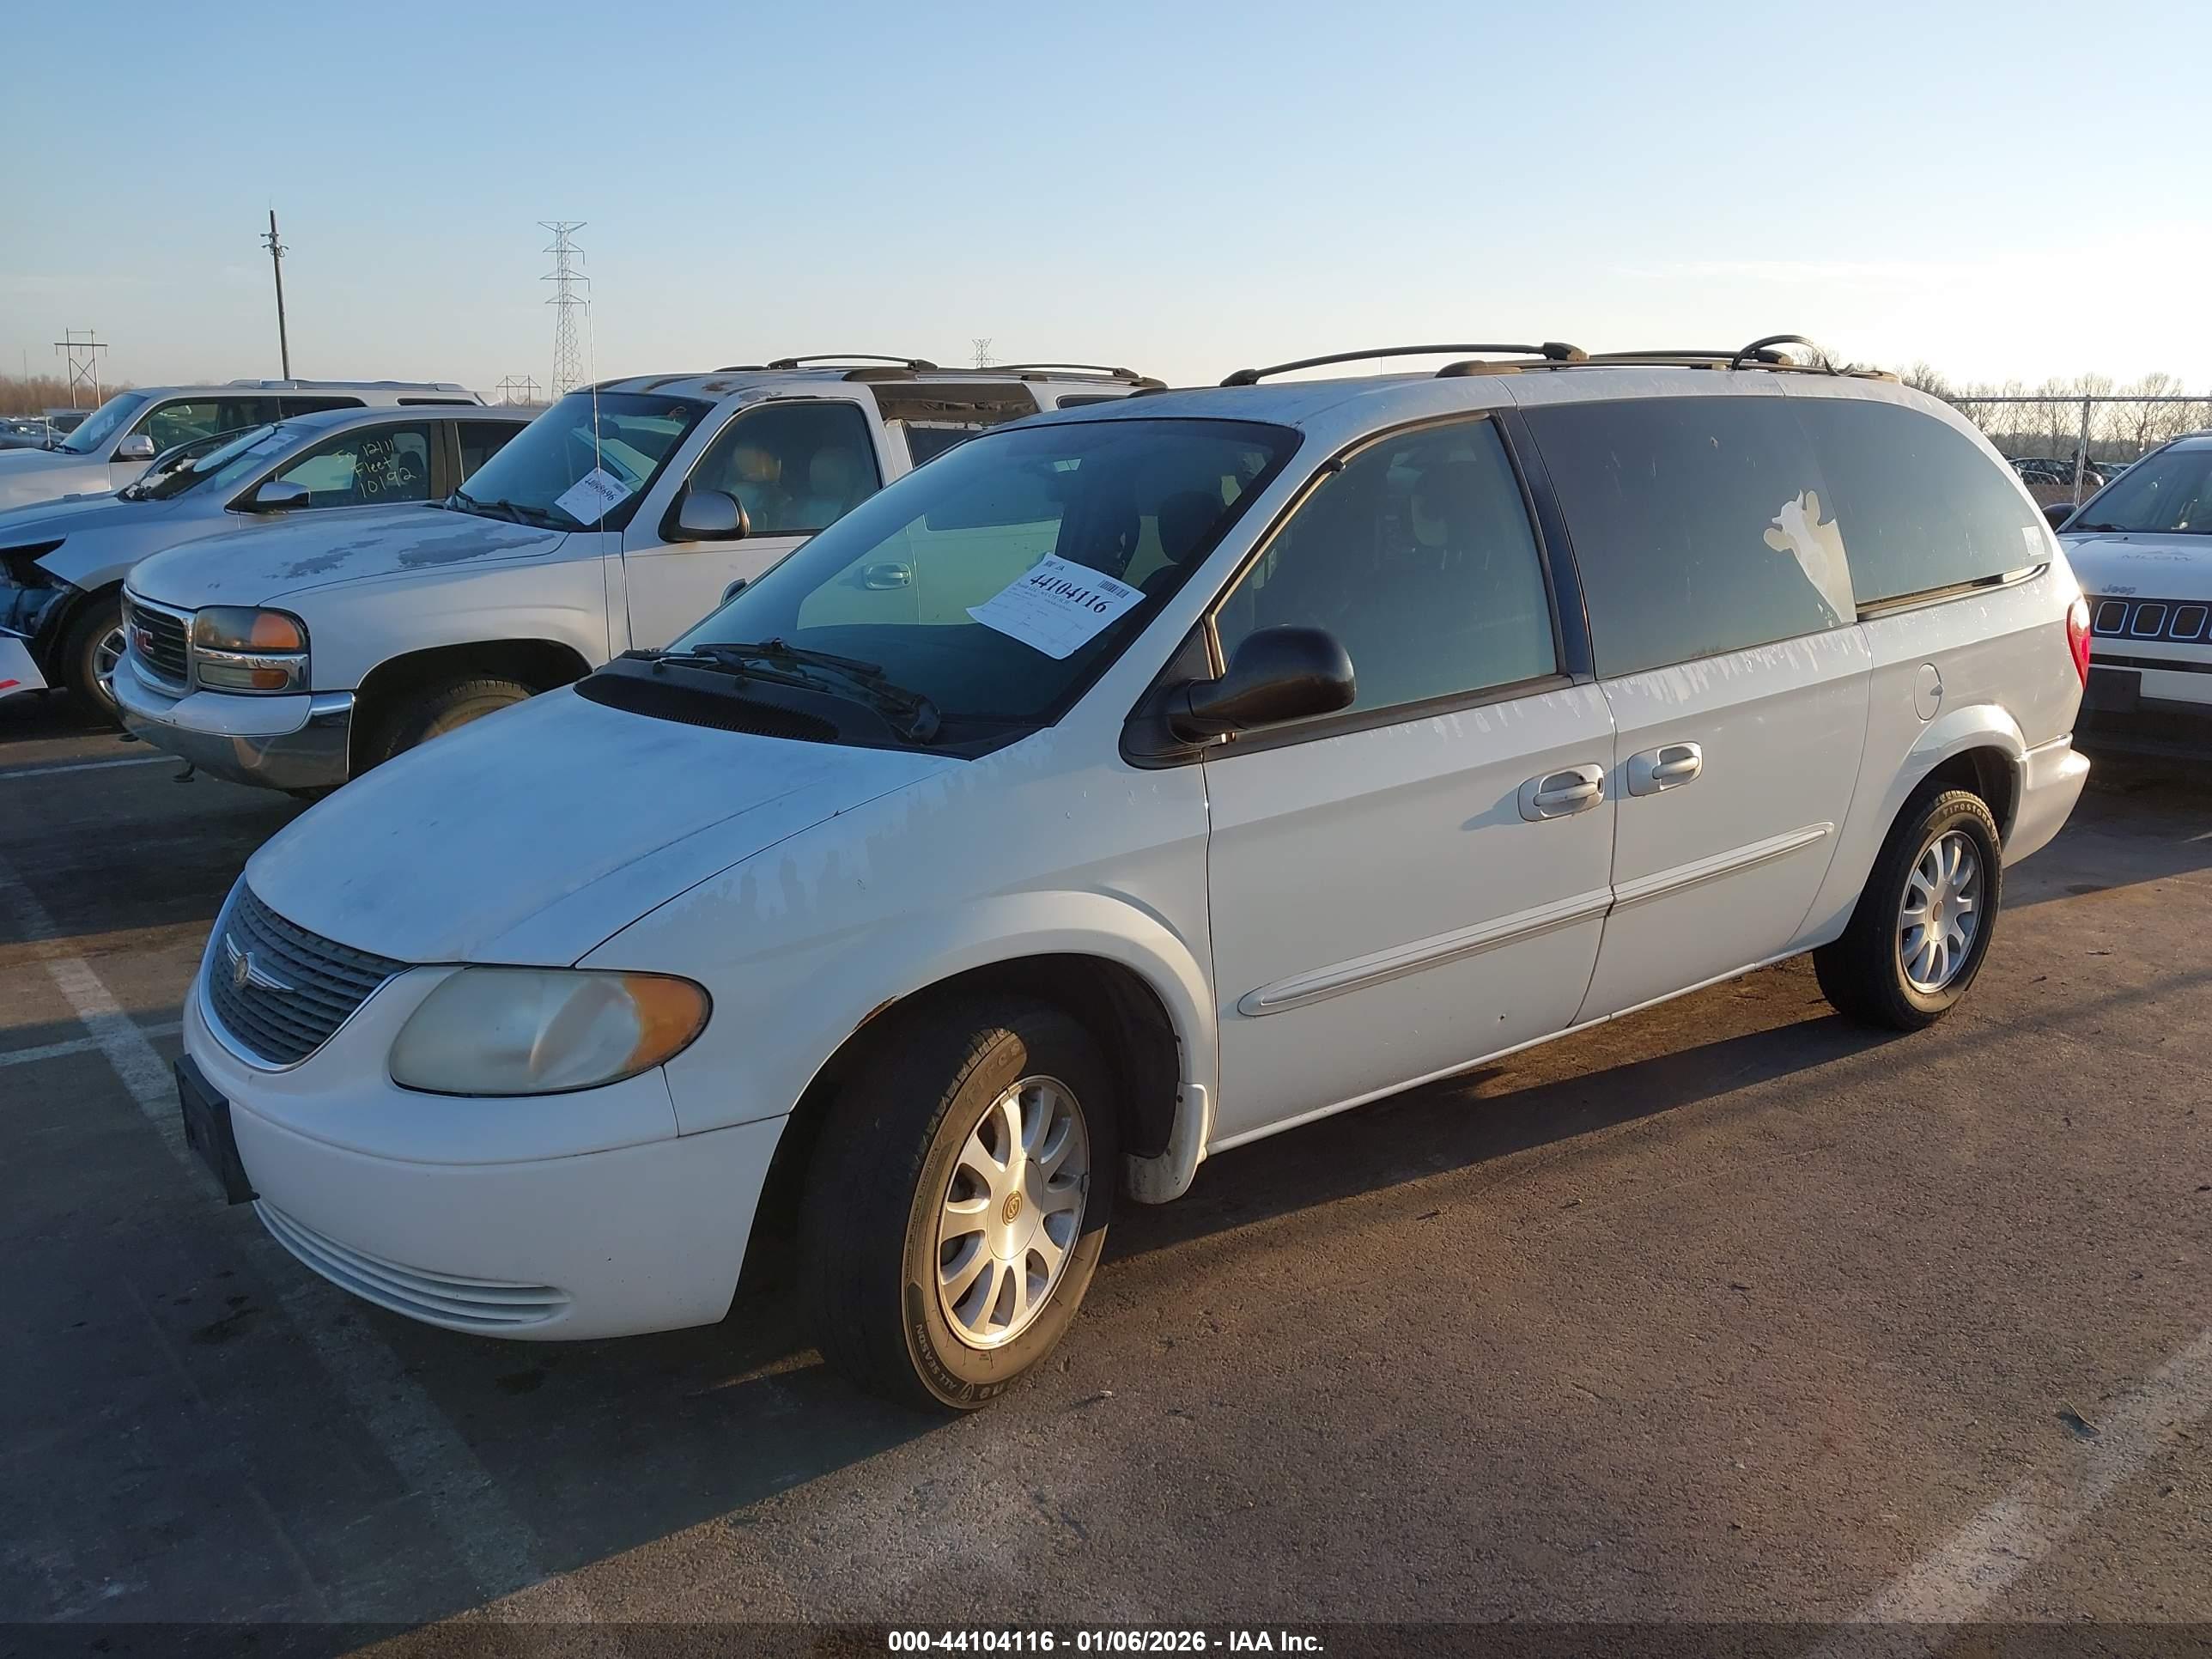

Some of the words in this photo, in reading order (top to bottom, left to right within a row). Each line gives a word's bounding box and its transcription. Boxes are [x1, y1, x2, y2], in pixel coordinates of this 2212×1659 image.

[350, 456, 392, 477] Fleet
[1030, 573, 1114, 614] 44104116
[1942, 803, 1992, 829] Firestone
[915, 1323, 941, 1375] SEASON
[939, 1373, 957, 1390] ALL
